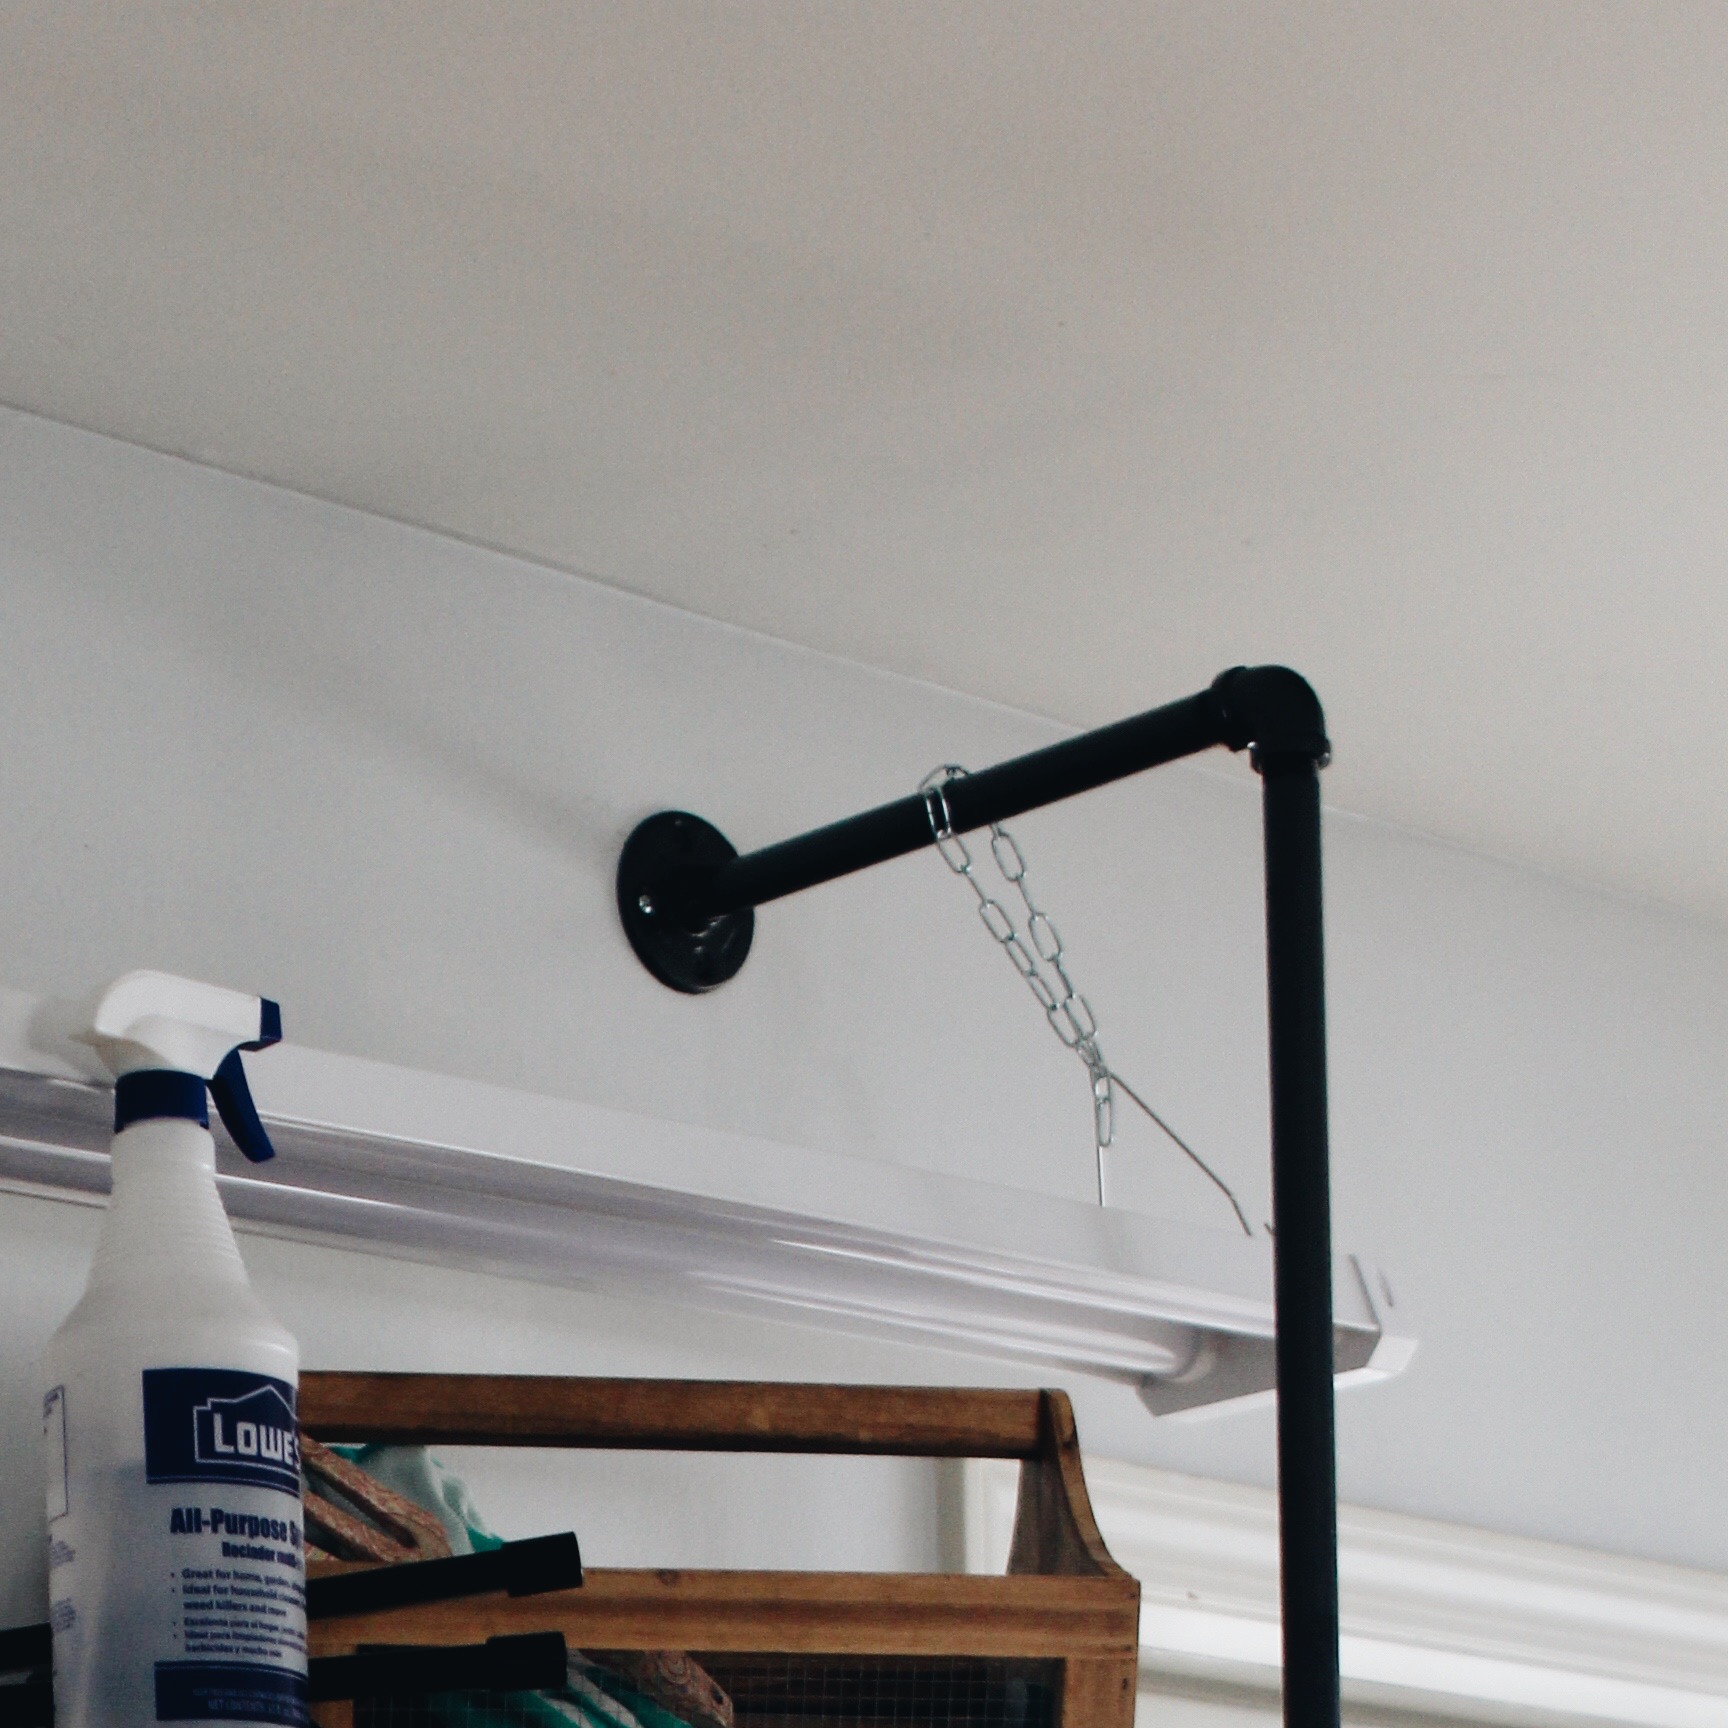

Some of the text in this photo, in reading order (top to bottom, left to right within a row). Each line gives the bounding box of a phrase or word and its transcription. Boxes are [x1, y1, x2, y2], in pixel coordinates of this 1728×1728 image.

[170, 1506, 288, 1542] All-Purpose
[181, 1567, 213, 1580] Great
[214, 1568, 231, 1580] for
[212, 1584, 229, 1595] for
